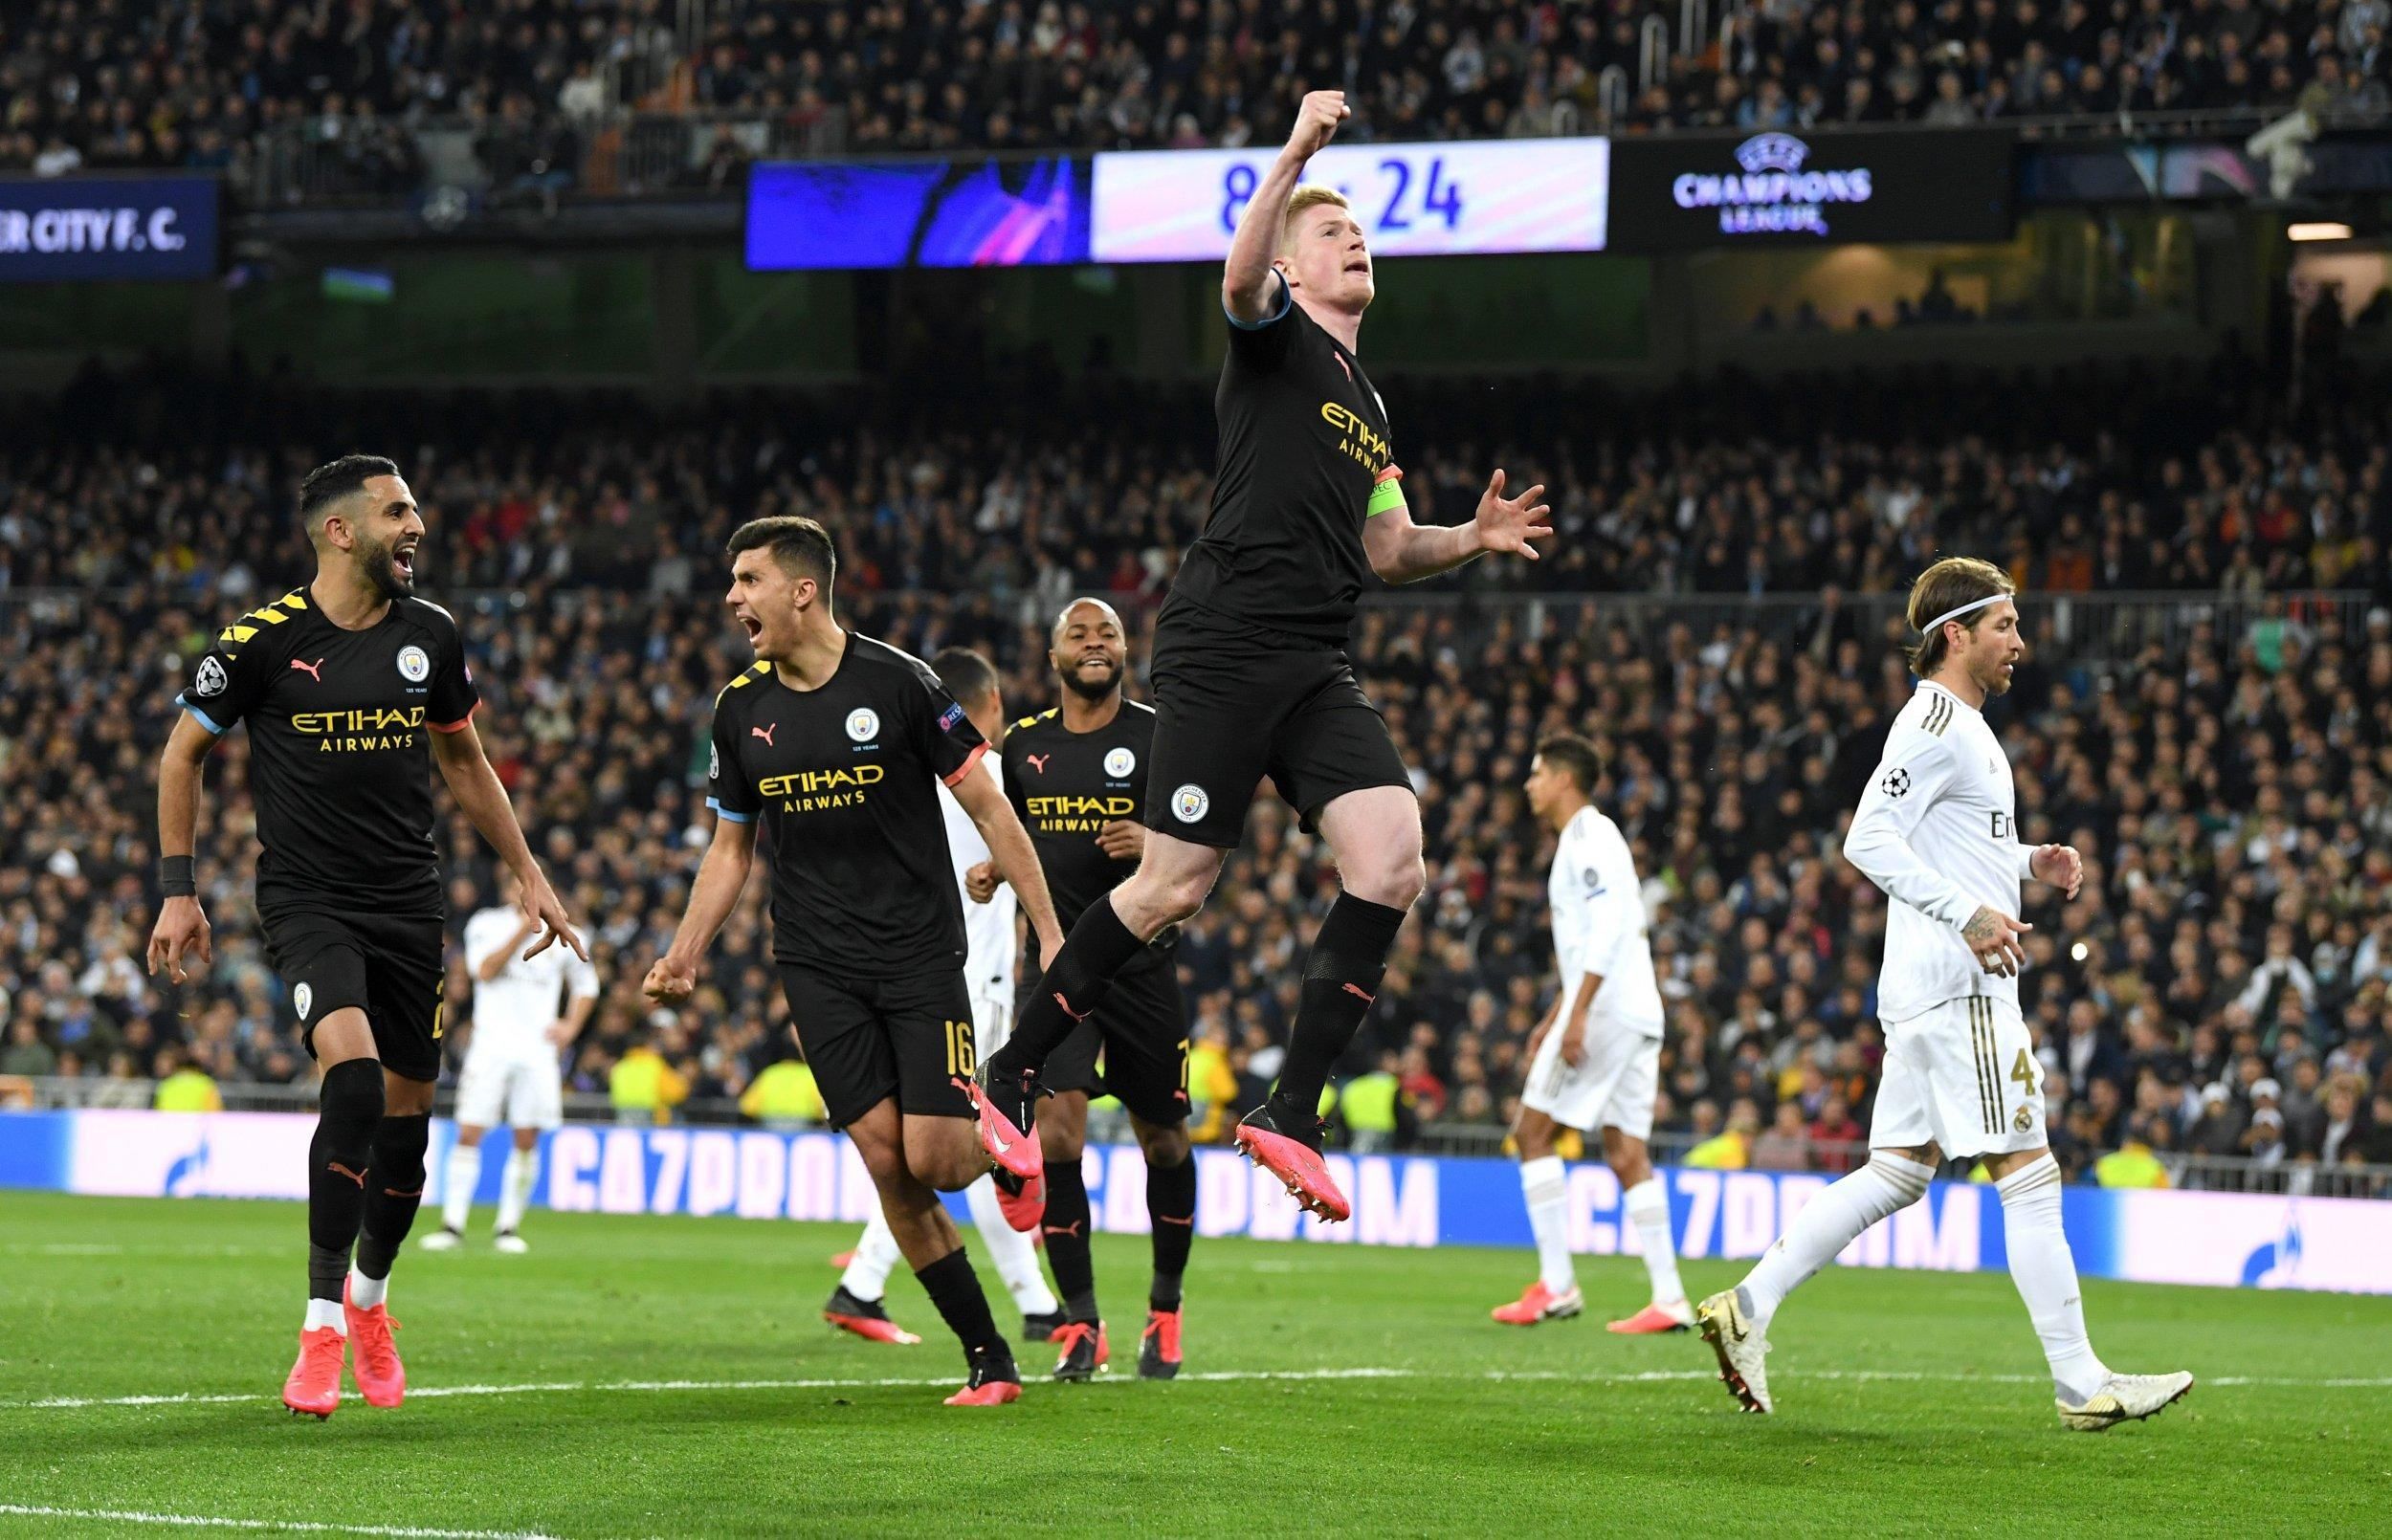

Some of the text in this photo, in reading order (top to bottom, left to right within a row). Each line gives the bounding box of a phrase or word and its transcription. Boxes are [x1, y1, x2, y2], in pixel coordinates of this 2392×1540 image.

[1377, 157, 1462, 230] 24
[32, 208, 113, 253] CITY
[291, 706, 425, 733] ETIHAD
[320, 734, 412, 752] AIRWAYS
[759, 764, 884, 797] ETIHAD
[785, 790, 865, 813] AIRWAYS
[1026, 796, 1135, 816] ETIHAD
[944, 1020, 975, 1077] 16
[2010, 1047, 2035, 1096] 4
